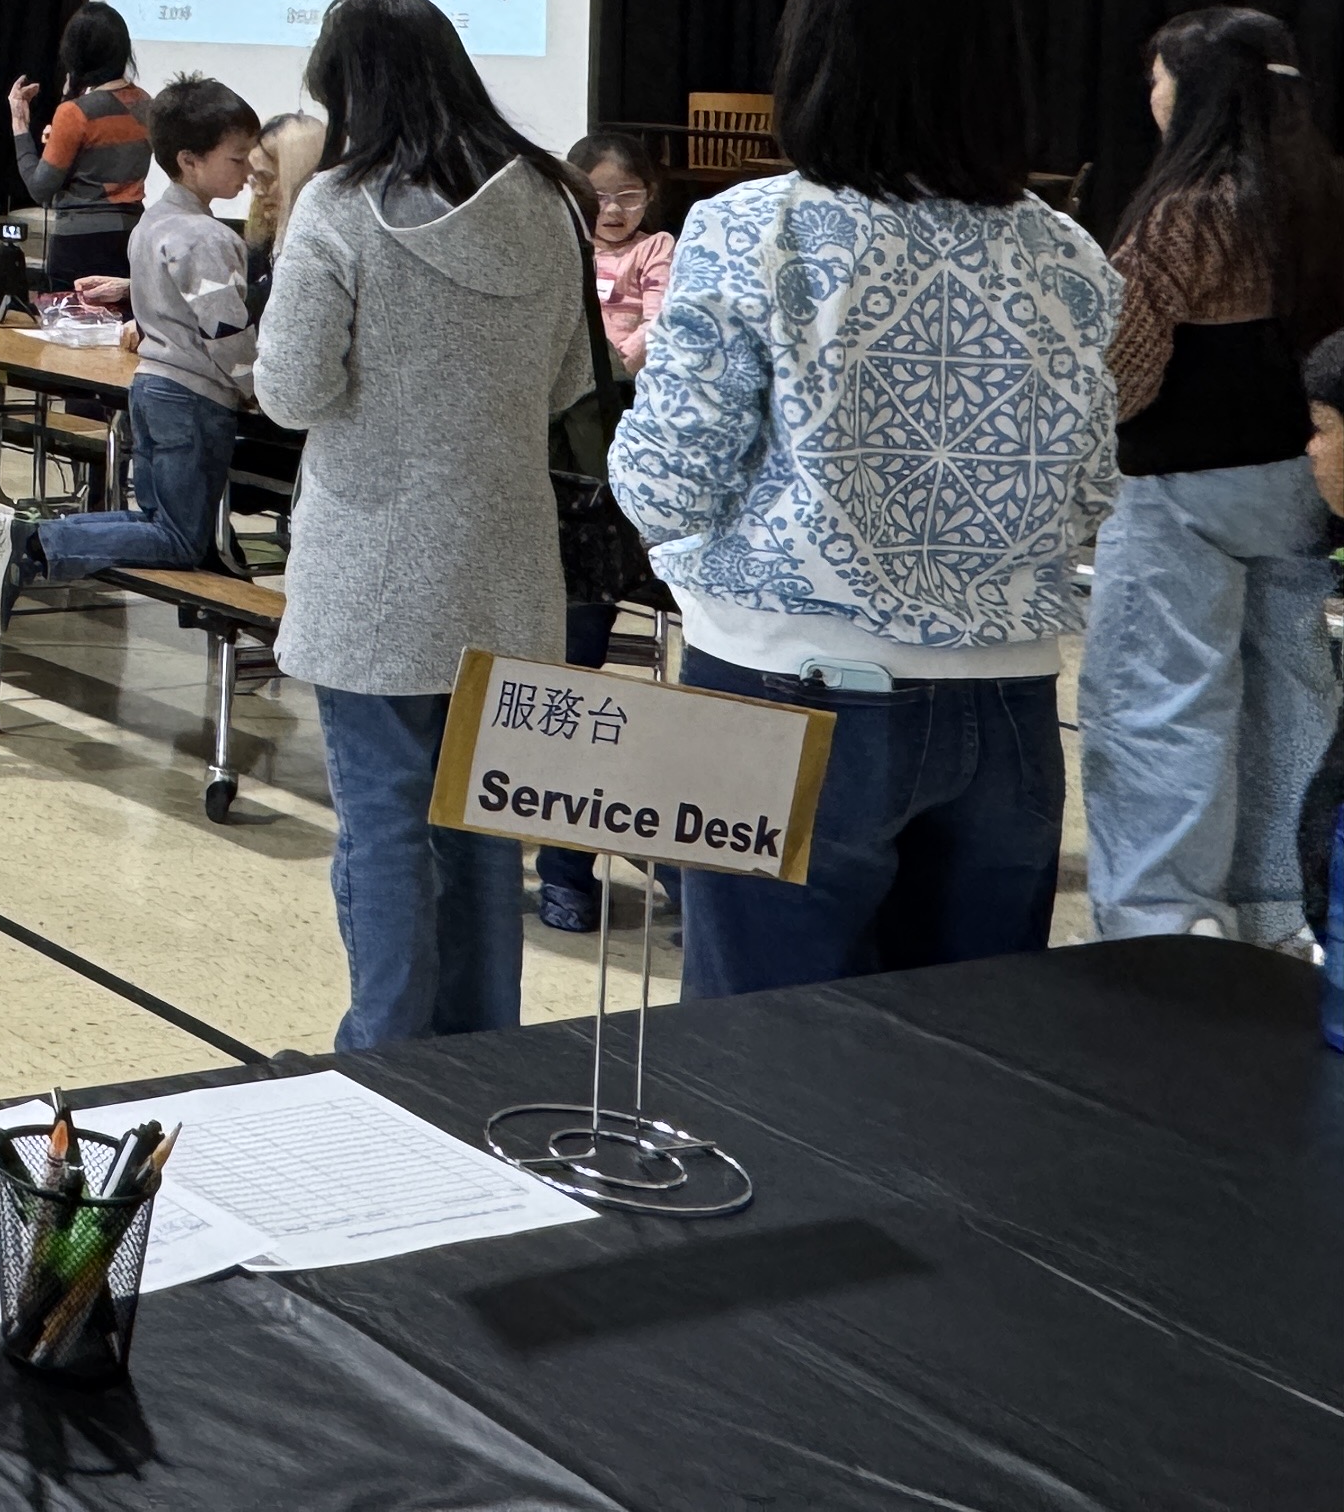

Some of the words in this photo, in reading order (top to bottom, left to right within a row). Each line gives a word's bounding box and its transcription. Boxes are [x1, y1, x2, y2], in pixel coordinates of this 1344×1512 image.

[491, 679, 628, 746] 服務台
[478, 769, 660, 839] Service
[674, 802, 783, 858] Desk
